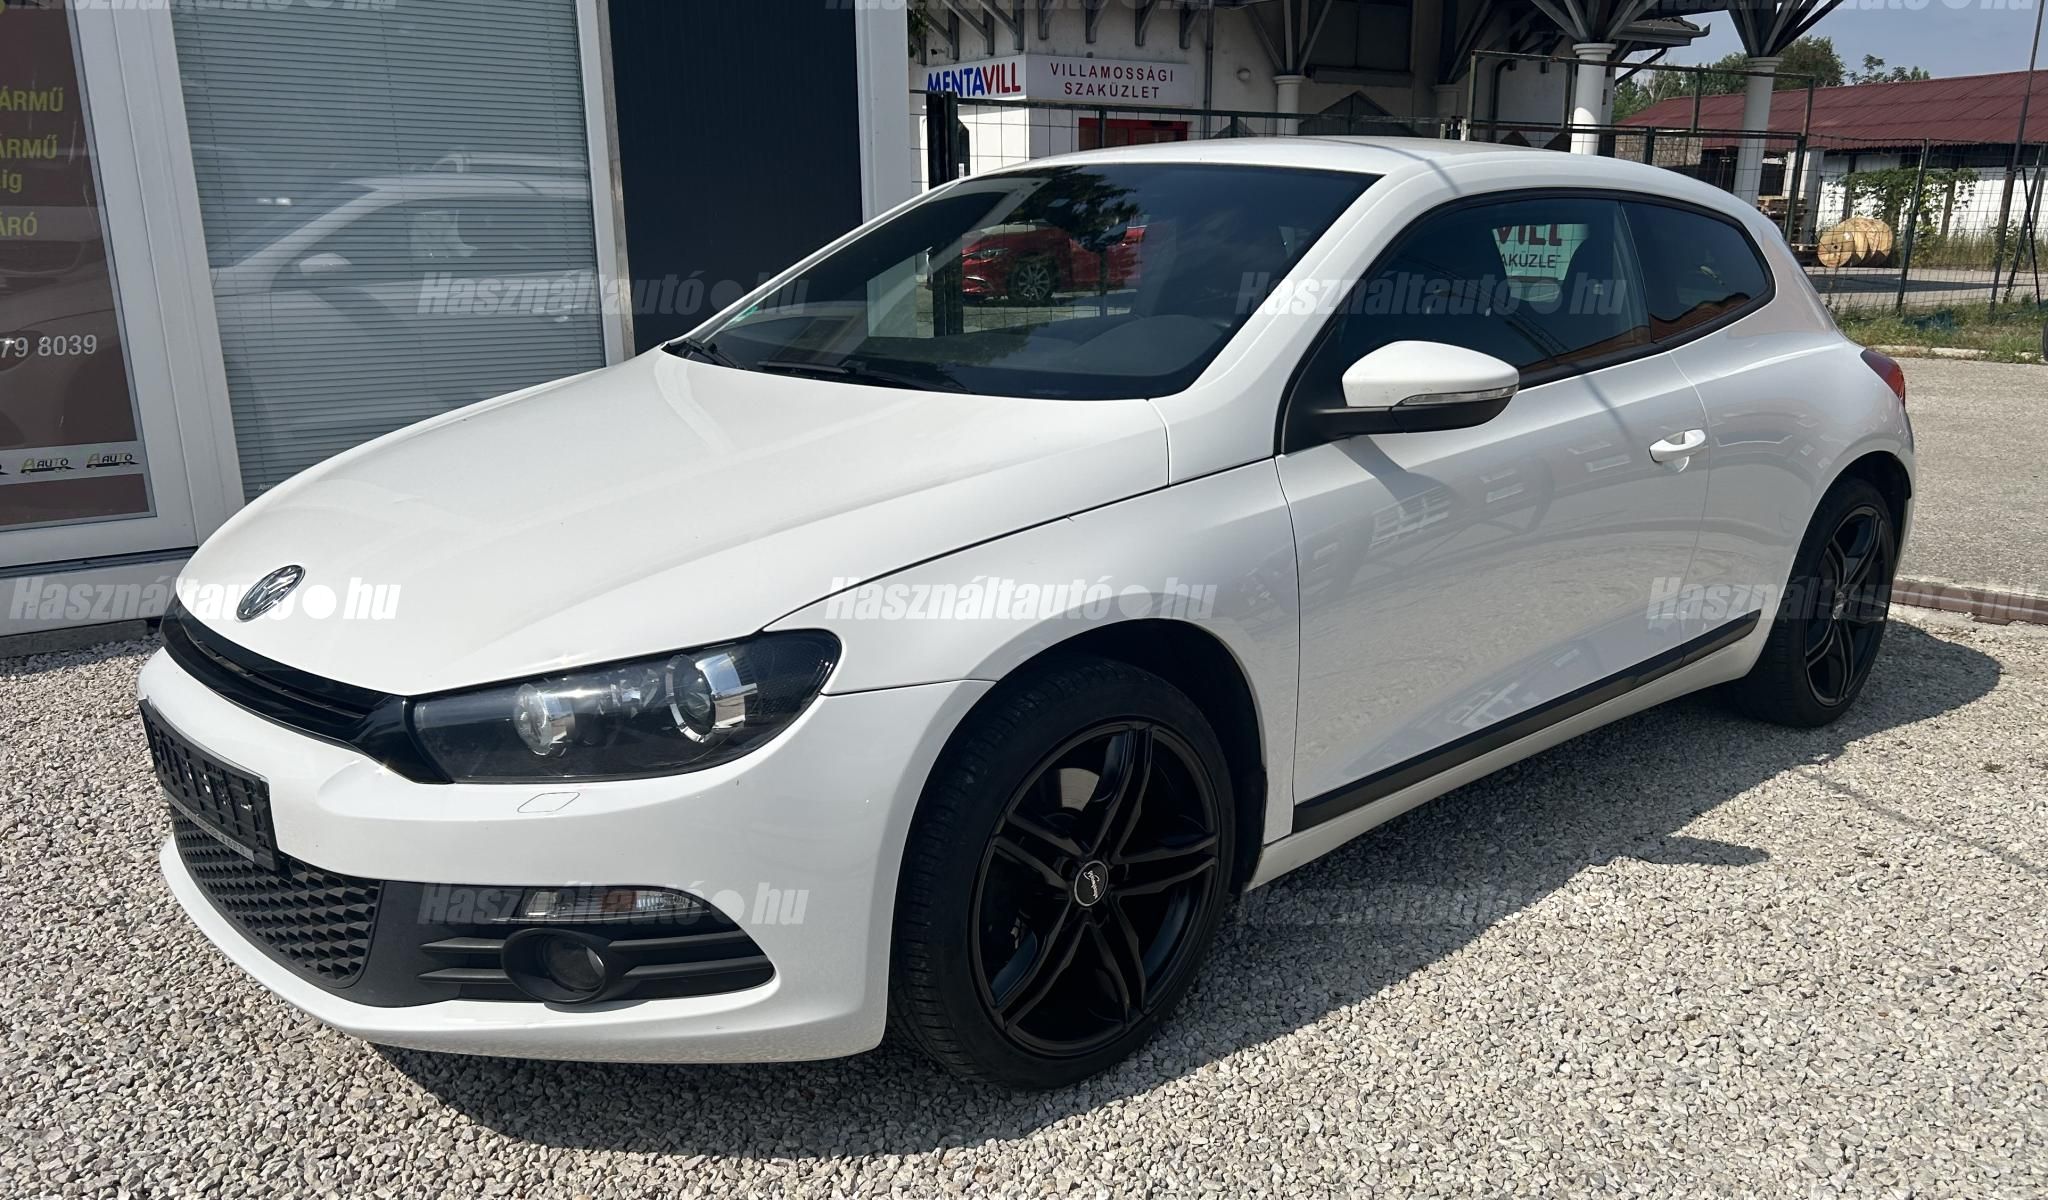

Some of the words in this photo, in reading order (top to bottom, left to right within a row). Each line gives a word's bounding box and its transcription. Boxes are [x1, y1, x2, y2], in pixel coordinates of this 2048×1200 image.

[927, 62, 1021, 97] MENTAVILL
[1050, 62, 1173, 82] VILLAMOSSÁGI
[1064, 81, 1160, 99] SZAKÜZLET
[38, 334, 97, 356] 8039
